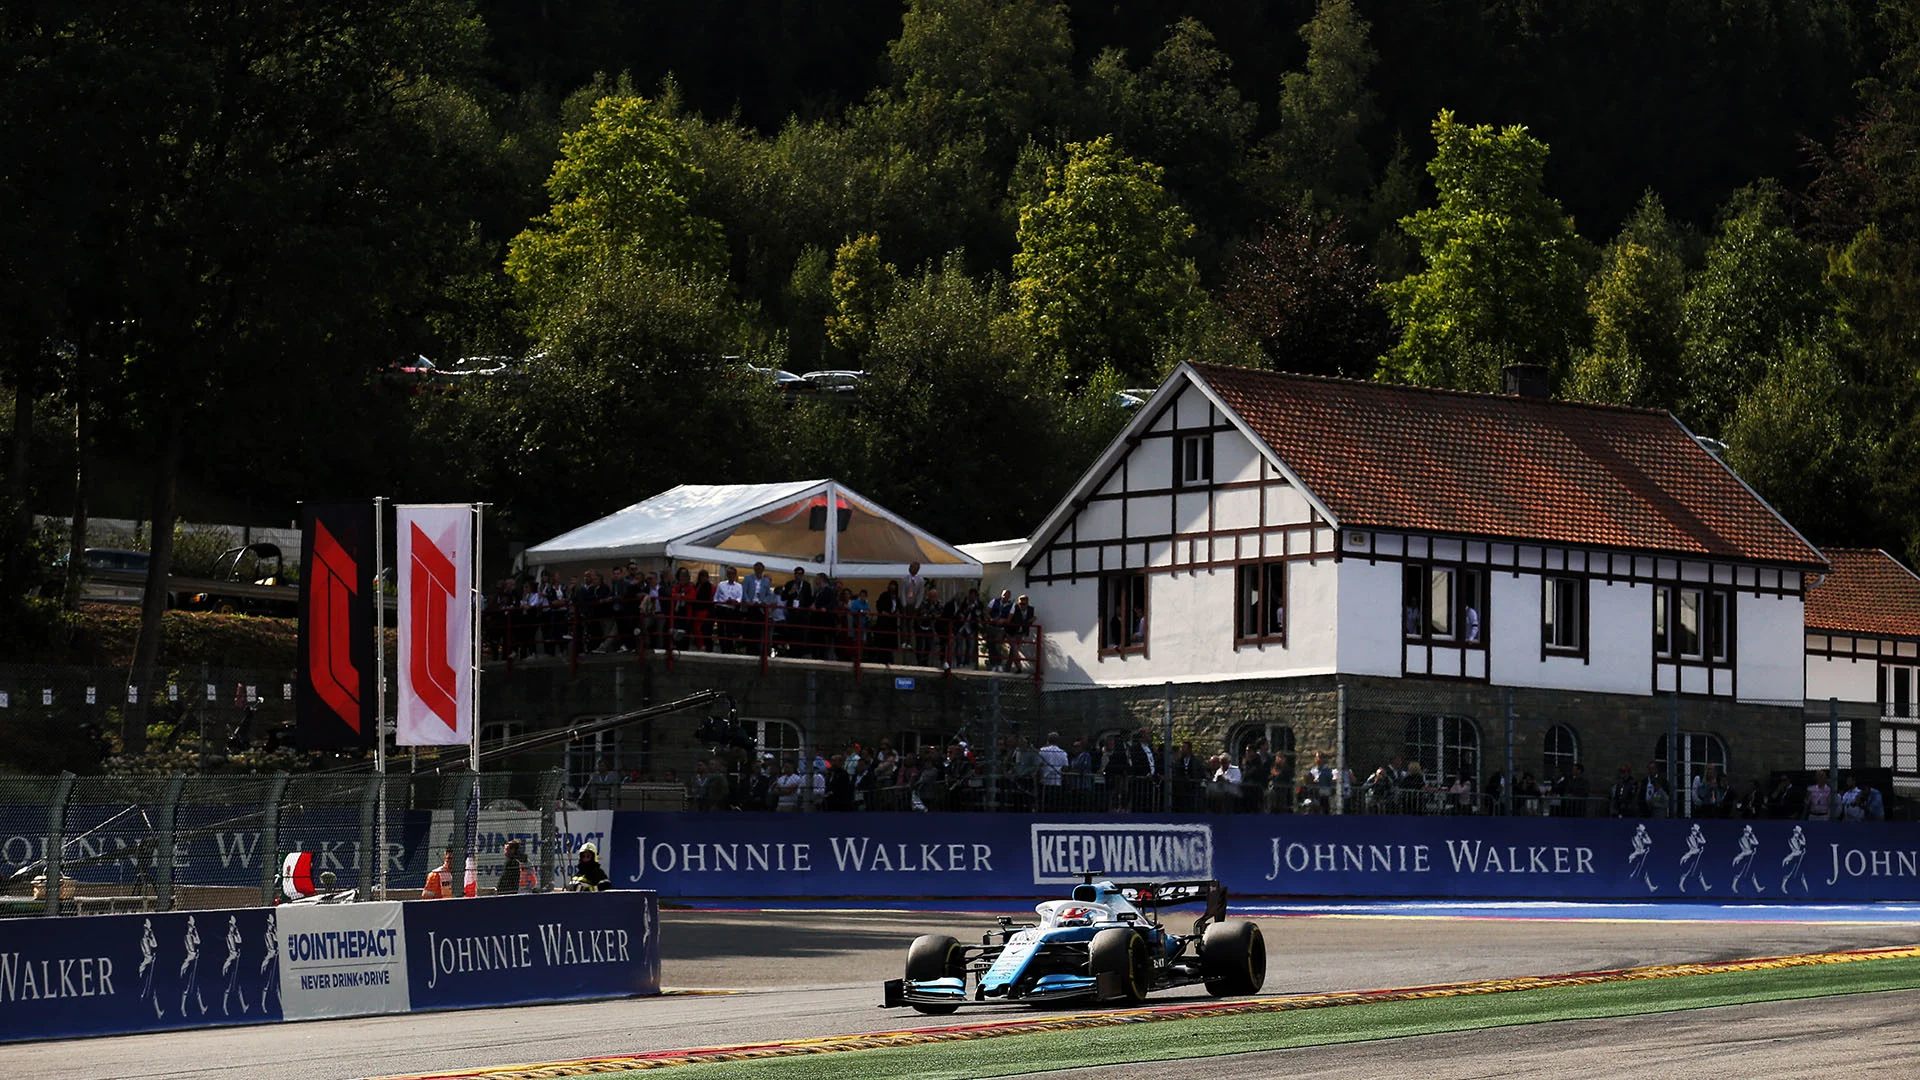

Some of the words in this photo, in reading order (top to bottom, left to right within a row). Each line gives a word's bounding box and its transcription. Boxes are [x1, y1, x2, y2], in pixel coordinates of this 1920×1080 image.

[629, 836, 812, 883] JOHNNIE
[829, 837, 993, 872] WALKER
[1040, 835, 1097, 873] KEEP
[1100, 835, 1203, 873] WALKING
[1265, 837, 1431, 881] JOHNNIE
[1445, 839, 1596, 873] WALKER
[1826, 843, 1918, 886] JOHN
[288, 928, 397, 962] #JOINTHEPACT
[428, 931, 532, 989] JOHNNIE
[538, 923, 630, 967] WALKER
[0, 952, 116, 1003] WALKER
[301, 974, 331, 990] NEVER
